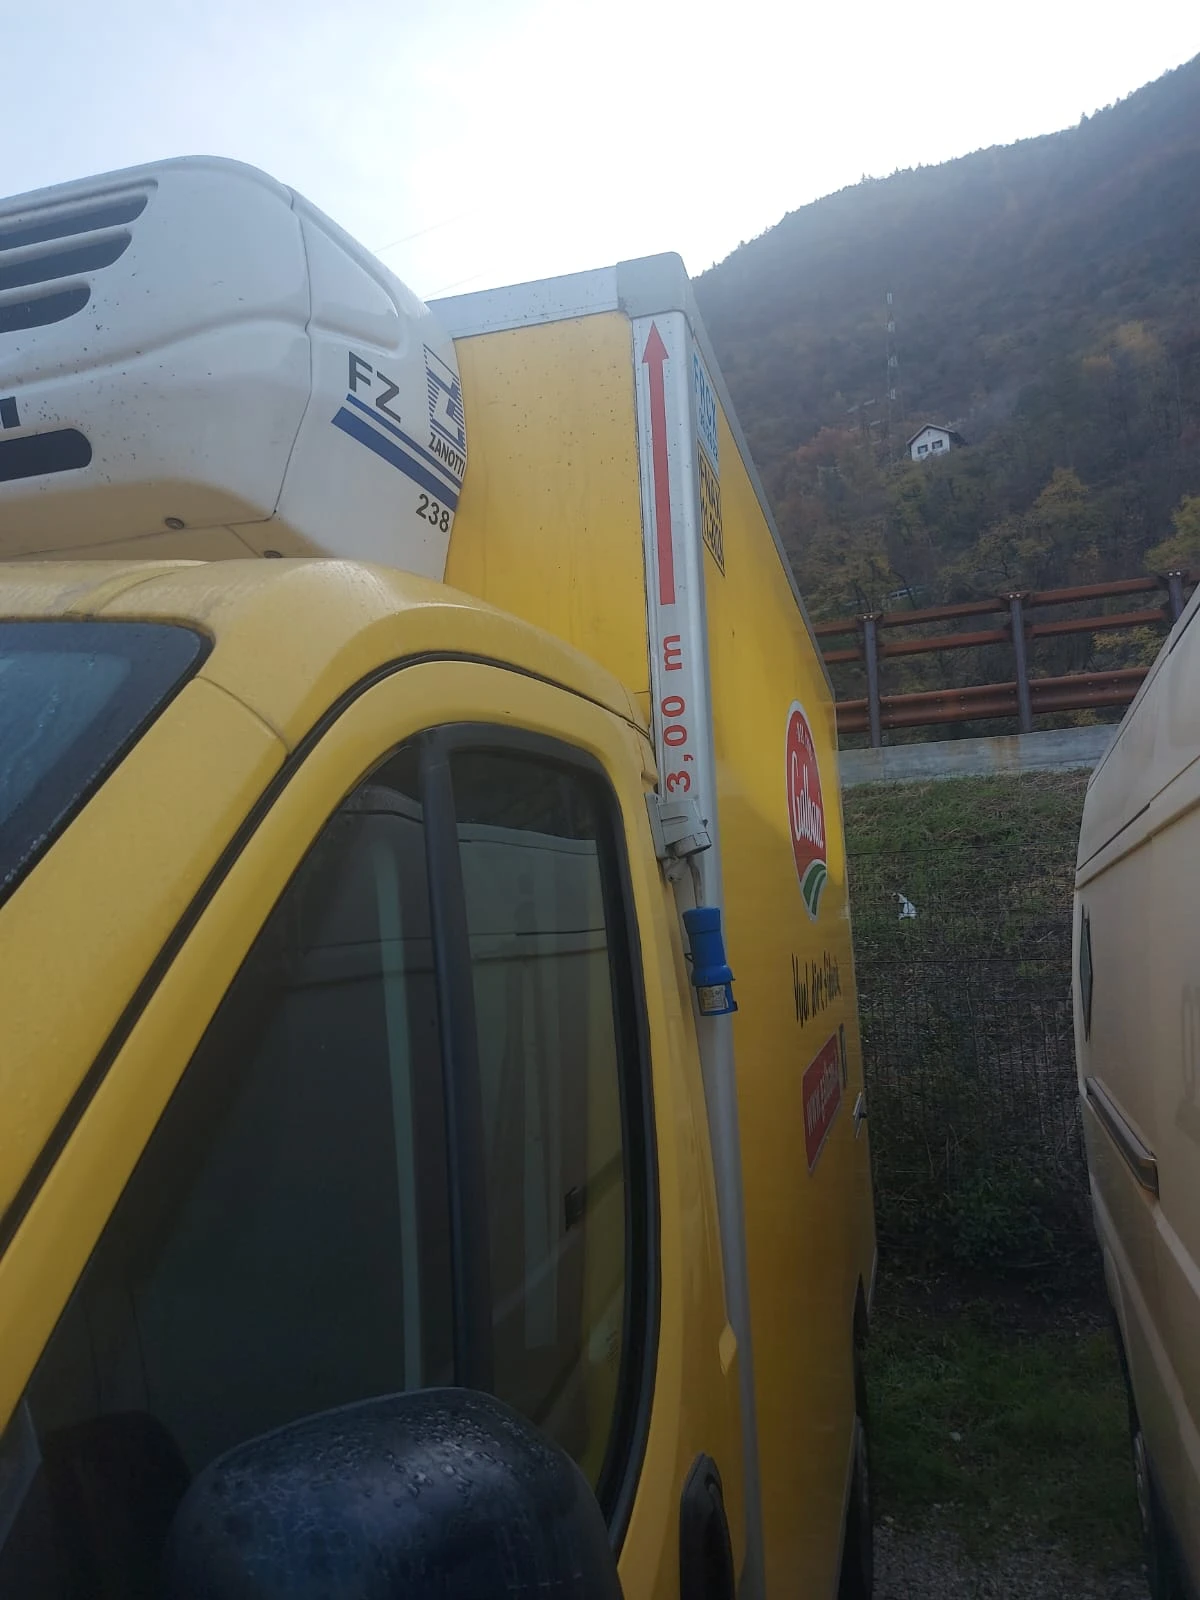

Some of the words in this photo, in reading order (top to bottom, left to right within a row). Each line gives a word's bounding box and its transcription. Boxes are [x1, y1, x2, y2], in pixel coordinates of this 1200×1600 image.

[349, 351, 401, 424] FZ
[428, 431, 466, 477] ZANOTTI
[415, 493, 450, 533] 238
[663, 634, 683, 672] m
[661, 695, 694, 793] 3,00
